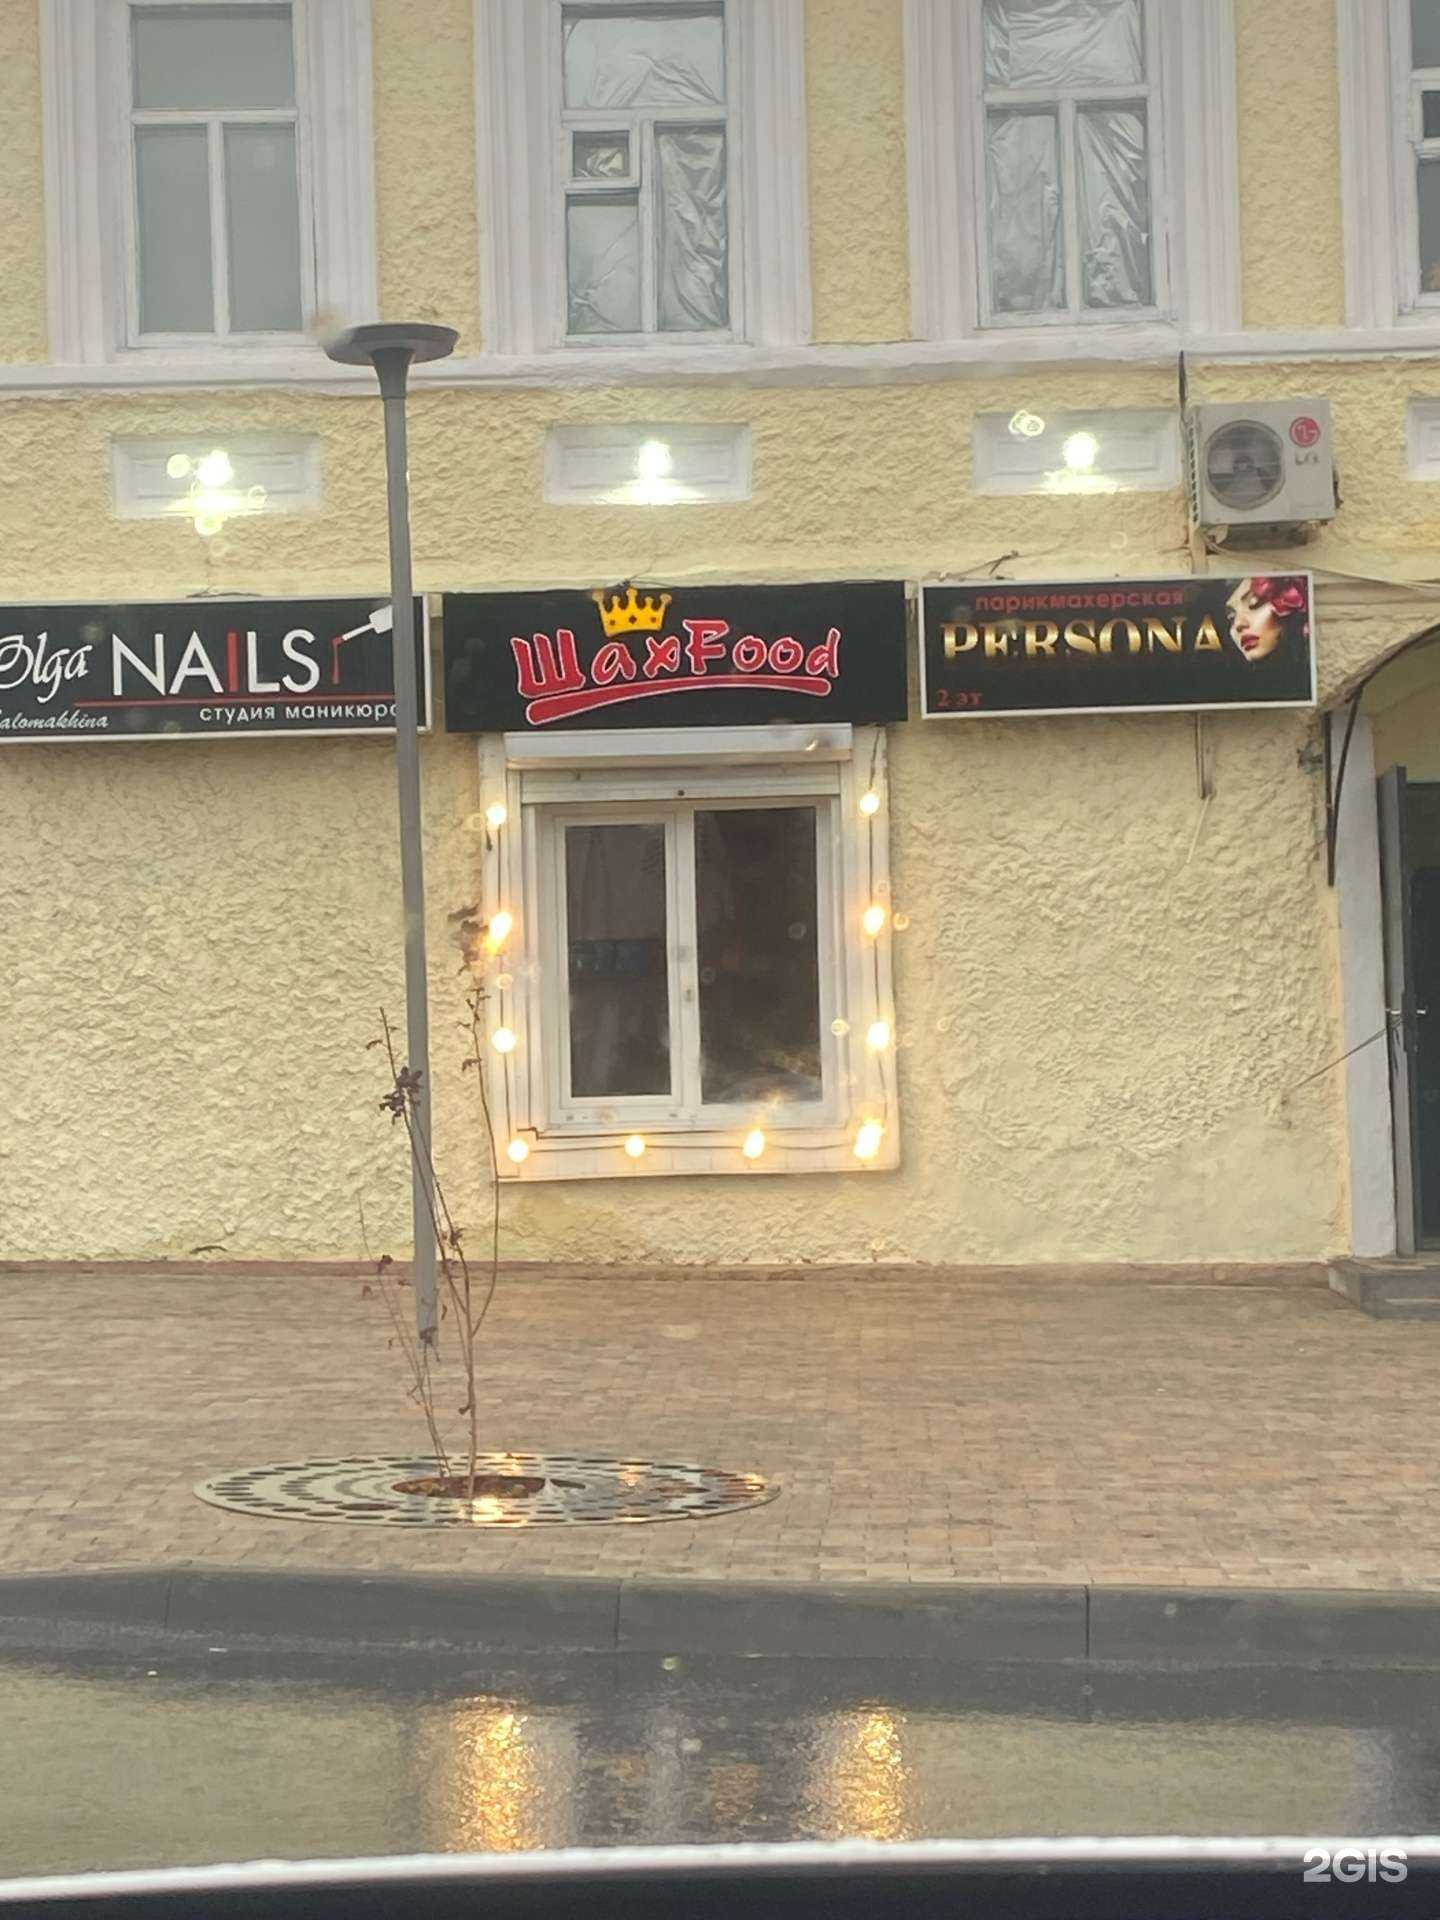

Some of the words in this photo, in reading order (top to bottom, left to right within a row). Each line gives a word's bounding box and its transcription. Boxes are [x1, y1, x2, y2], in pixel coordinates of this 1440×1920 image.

[975, 588, 1184, 613] парикмахерская
[940, 614, 1223, 660] PERSONA
[0, 631, 93, 704] Olga
[112, 629, 321, 696] NAILS
[0, 709, 109, 730] alomakhina
[199, 705, 276, 725] студия
